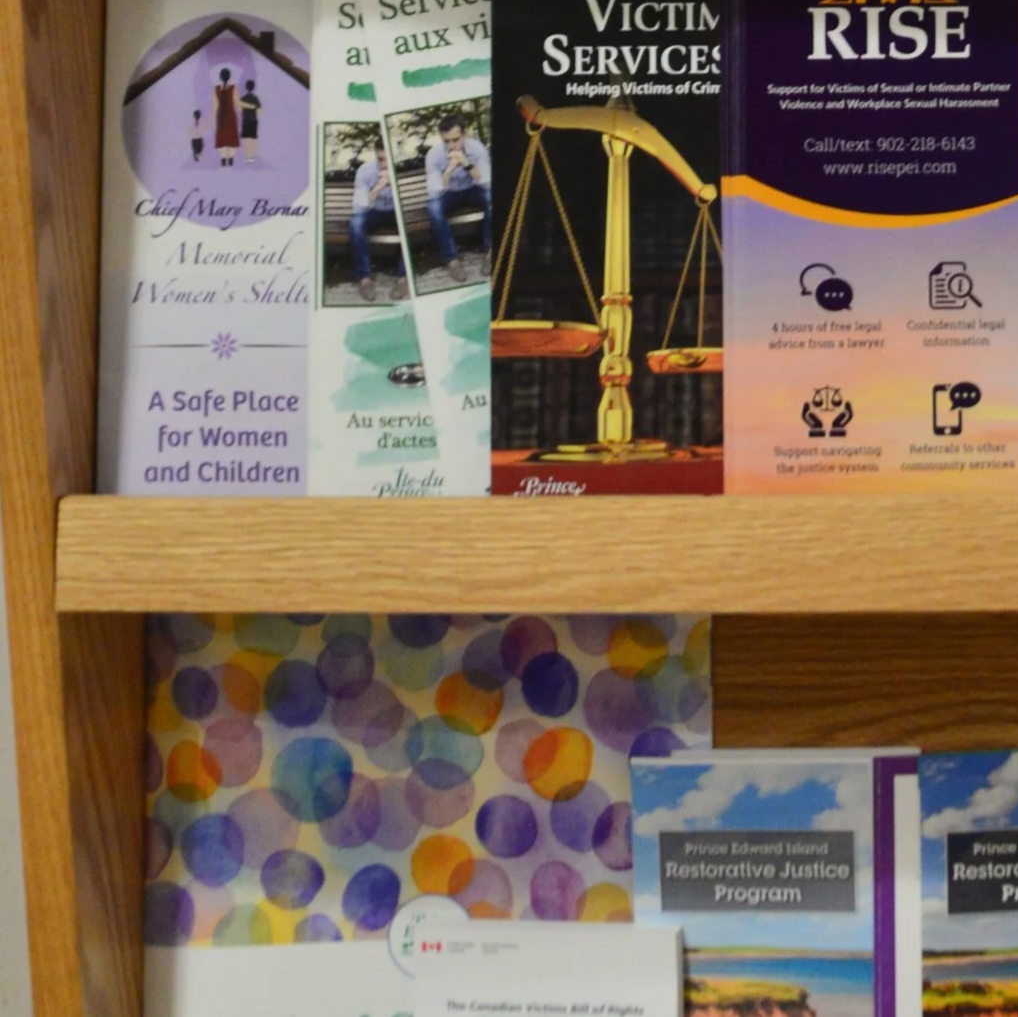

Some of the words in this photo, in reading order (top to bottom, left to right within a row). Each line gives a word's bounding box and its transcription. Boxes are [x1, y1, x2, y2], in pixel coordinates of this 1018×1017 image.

[394, 26, 451, 55] aux
[807, 6, 970, 60] RISE
[566, 83, 620, 97] Helping
[623, 83, 672, 95] Victims
[675, 82, 690, 94] of
[780, 99, 823, 109] Violence
[877, 137, 975, 151] 902-218-6143
[823, 162, 956, 176] www.risepei.com
[135, 188, 200, 237] Chief
[190, 199, 242, 231] Mary
[165, 232, 303, 266] Memorial
[132, 279, 234, 304] Women's
[148, 392, 163, 411] A
[173, 390, 228, 416] Safe
[233, 391, 299, 411] Place
[158, 425, 192, 452] for
[199, 427, 287, 447] Women
[144, 461, 189, 482] and
[197, 460, 299, 482] Children
[973, 841, 1016, 855] Prince
[665, 861, 775, 879] Restorative
[780, 861, 849, 878] Justice
[714, 884, 801, 904] Program
